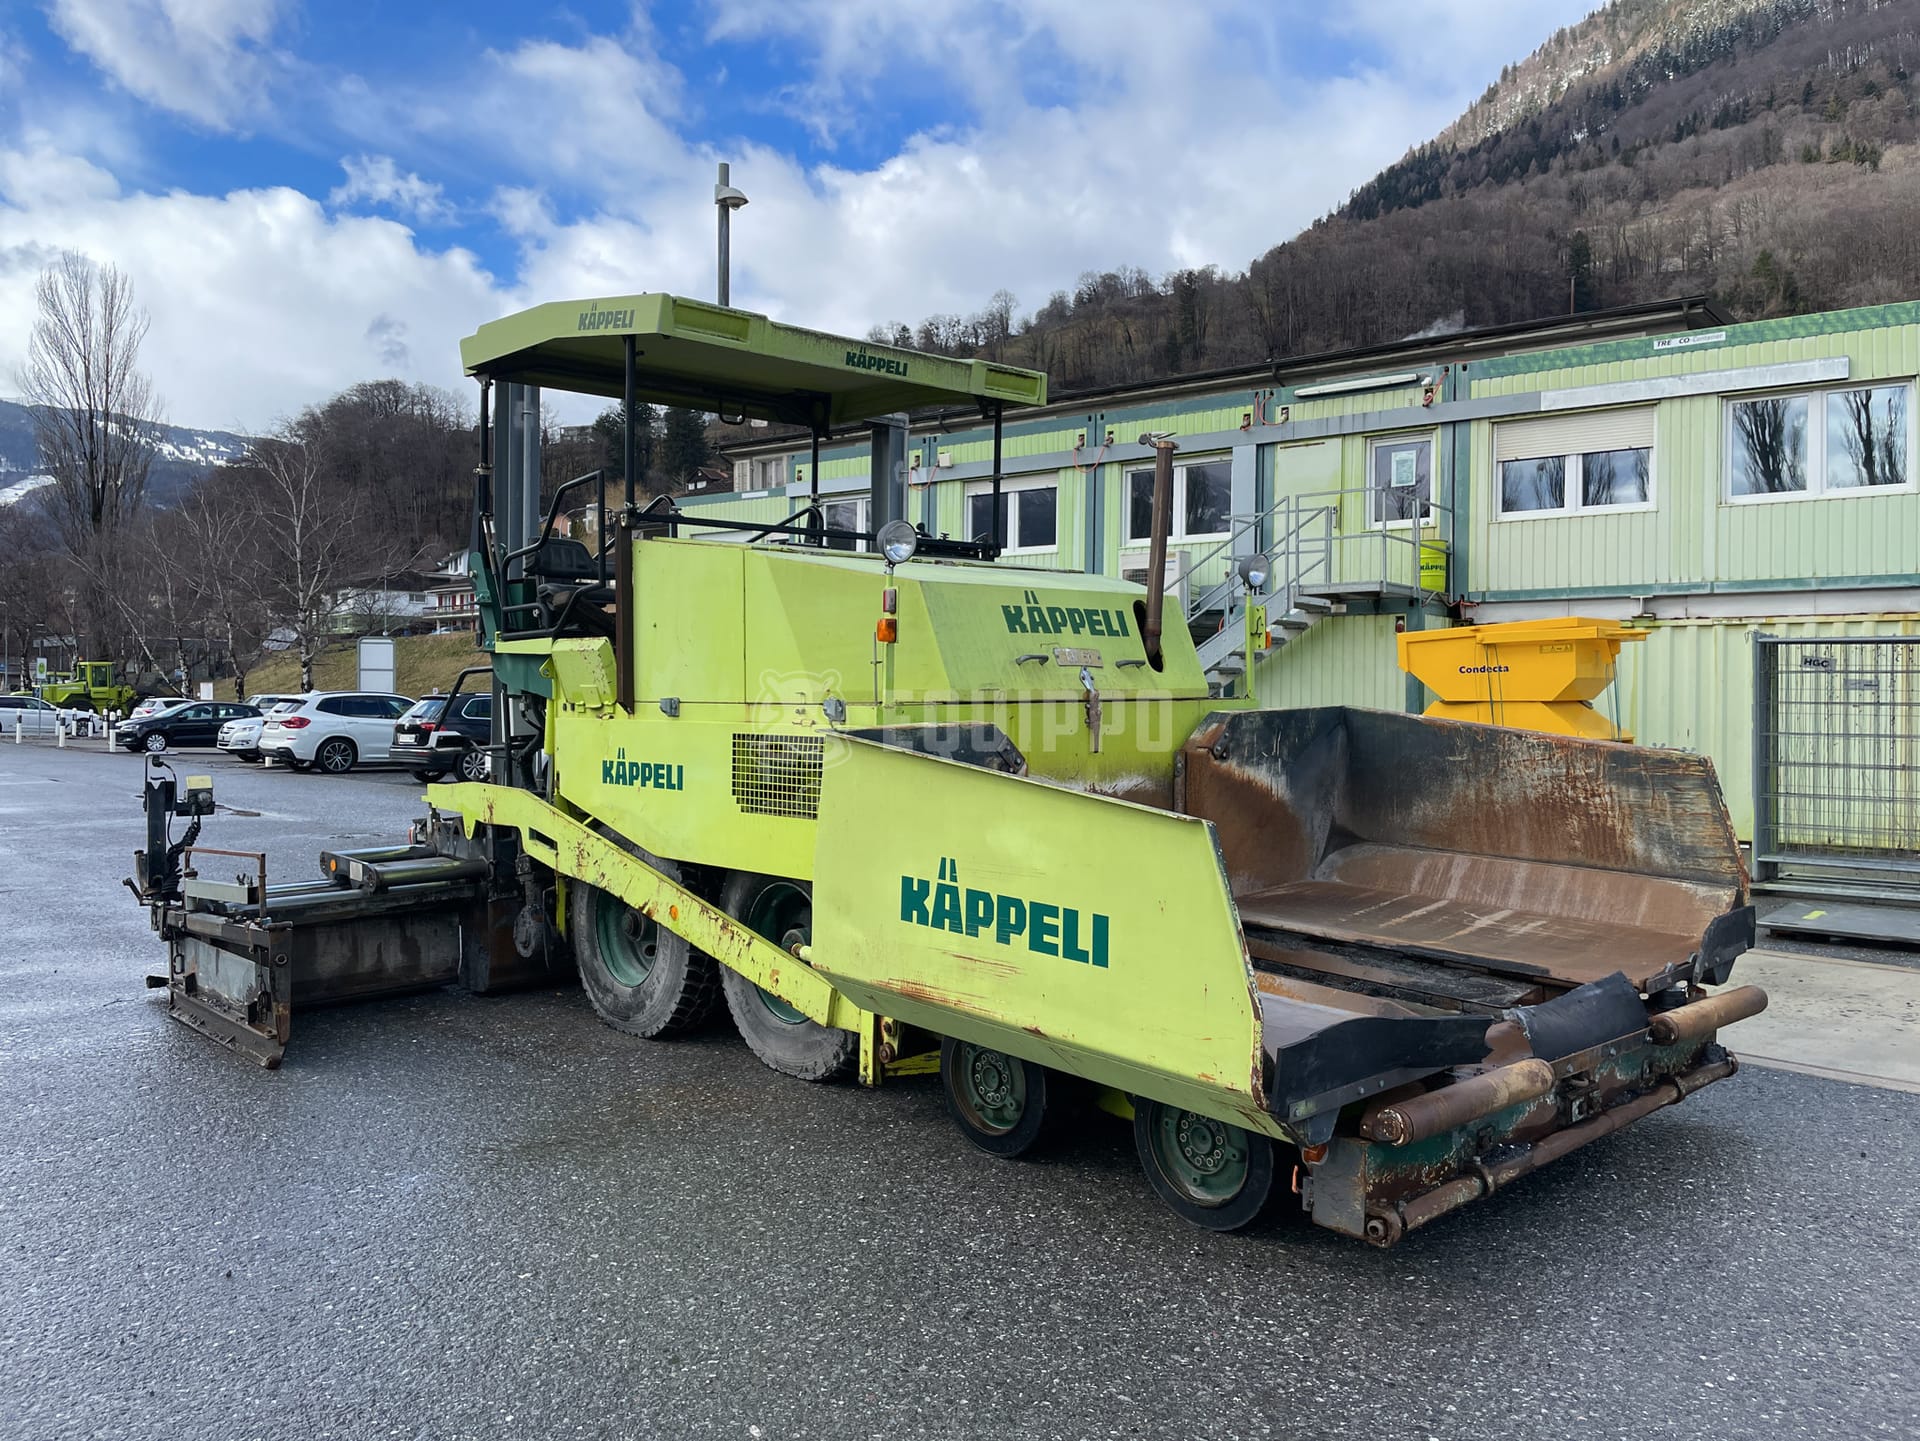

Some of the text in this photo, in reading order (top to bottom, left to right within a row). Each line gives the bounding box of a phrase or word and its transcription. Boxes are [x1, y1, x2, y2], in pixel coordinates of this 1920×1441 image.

[578, 301, 635, 331] KÄPPELI
[845, 345, 908, 376] KÄPPELI
[1001, 590, 1130, 637] KÄPPELI
[1458, 665, 1509, 674] Condecta
[1803, 658, 1830, 668] HGC
[602, 747, 683, 791] KÄPPELI
[901, 856, 1110, 969] KÄPPELI
